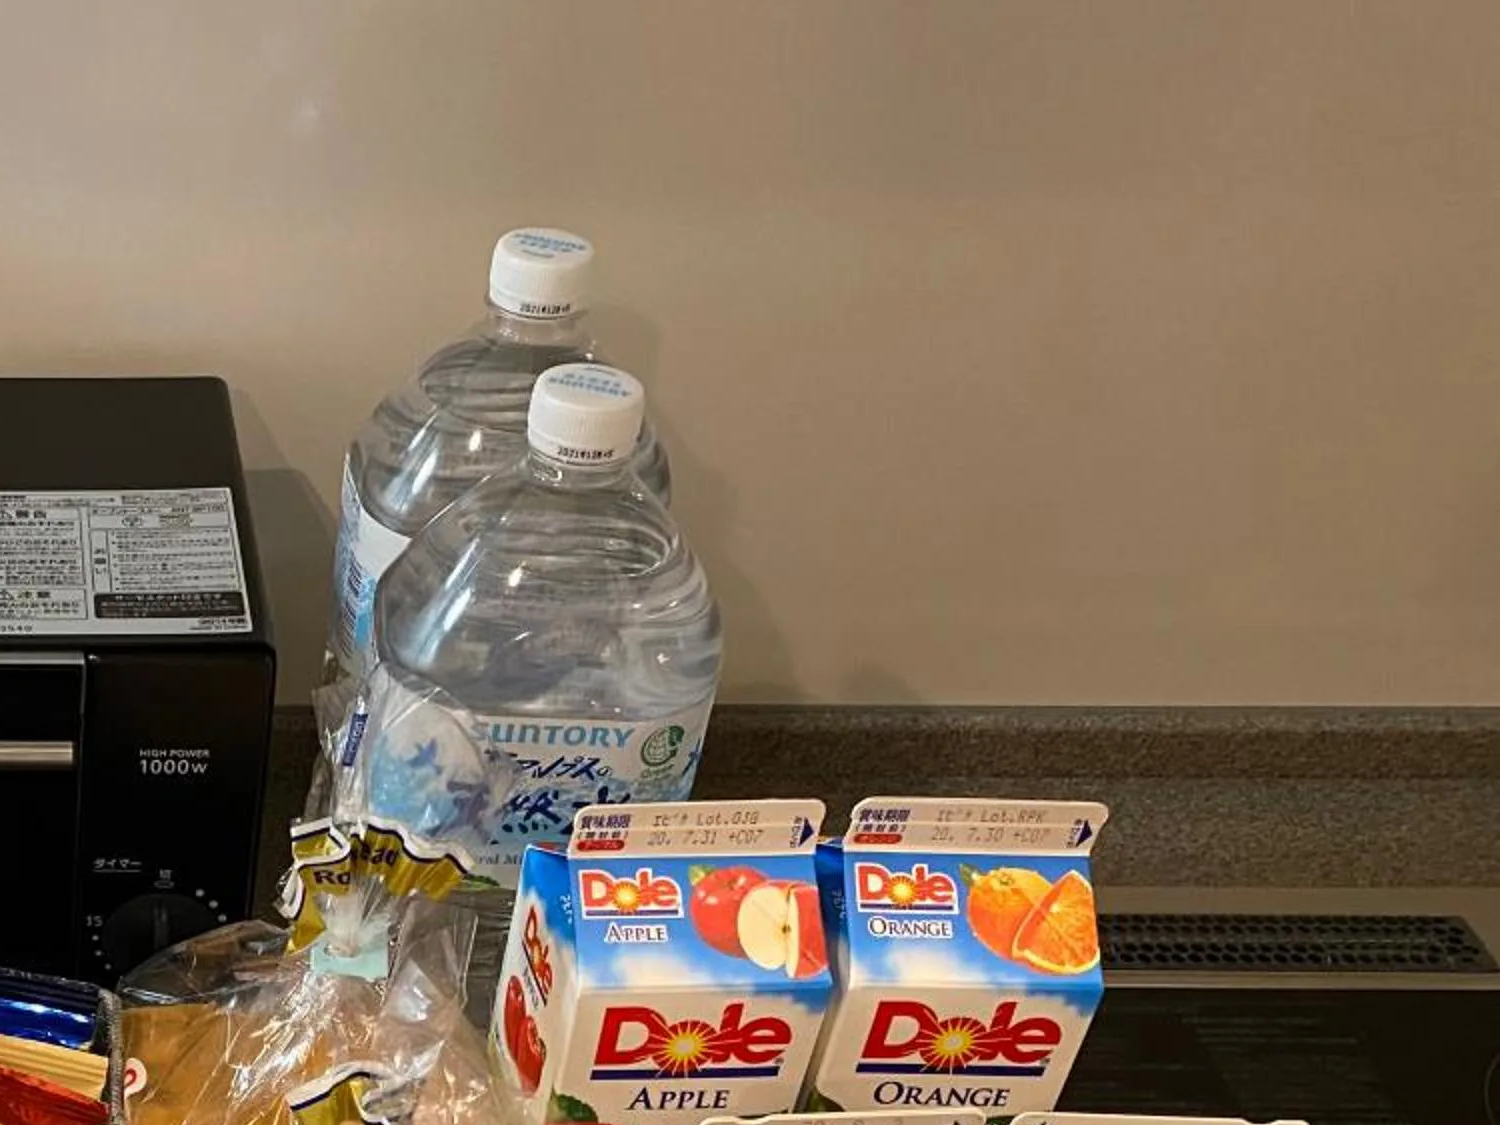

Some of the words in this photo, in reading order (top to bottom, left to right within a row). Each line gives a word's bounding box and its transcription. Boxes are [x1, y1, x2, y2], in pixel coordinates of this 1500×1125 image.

[139, 749, 167, 758] HIGH
[169, 749, 210, 758] POWER
[484, 750, 612, 780] アルプスの
[93, 858, 142, 869] タイマー
[582, 869, 678, 911] Dole
[857, 864, 955, 905] Dole
[607, 924, 668, 942] APPLE
[869, 918, 952, 937] ORANGE
[594, 1003, 793, 1070] Dole
[862, 1001, 1062, 1066] Dole
[628, 1086, 730, 1111] APPLE
[874, 1081, 1011, 1109] ORANGE
